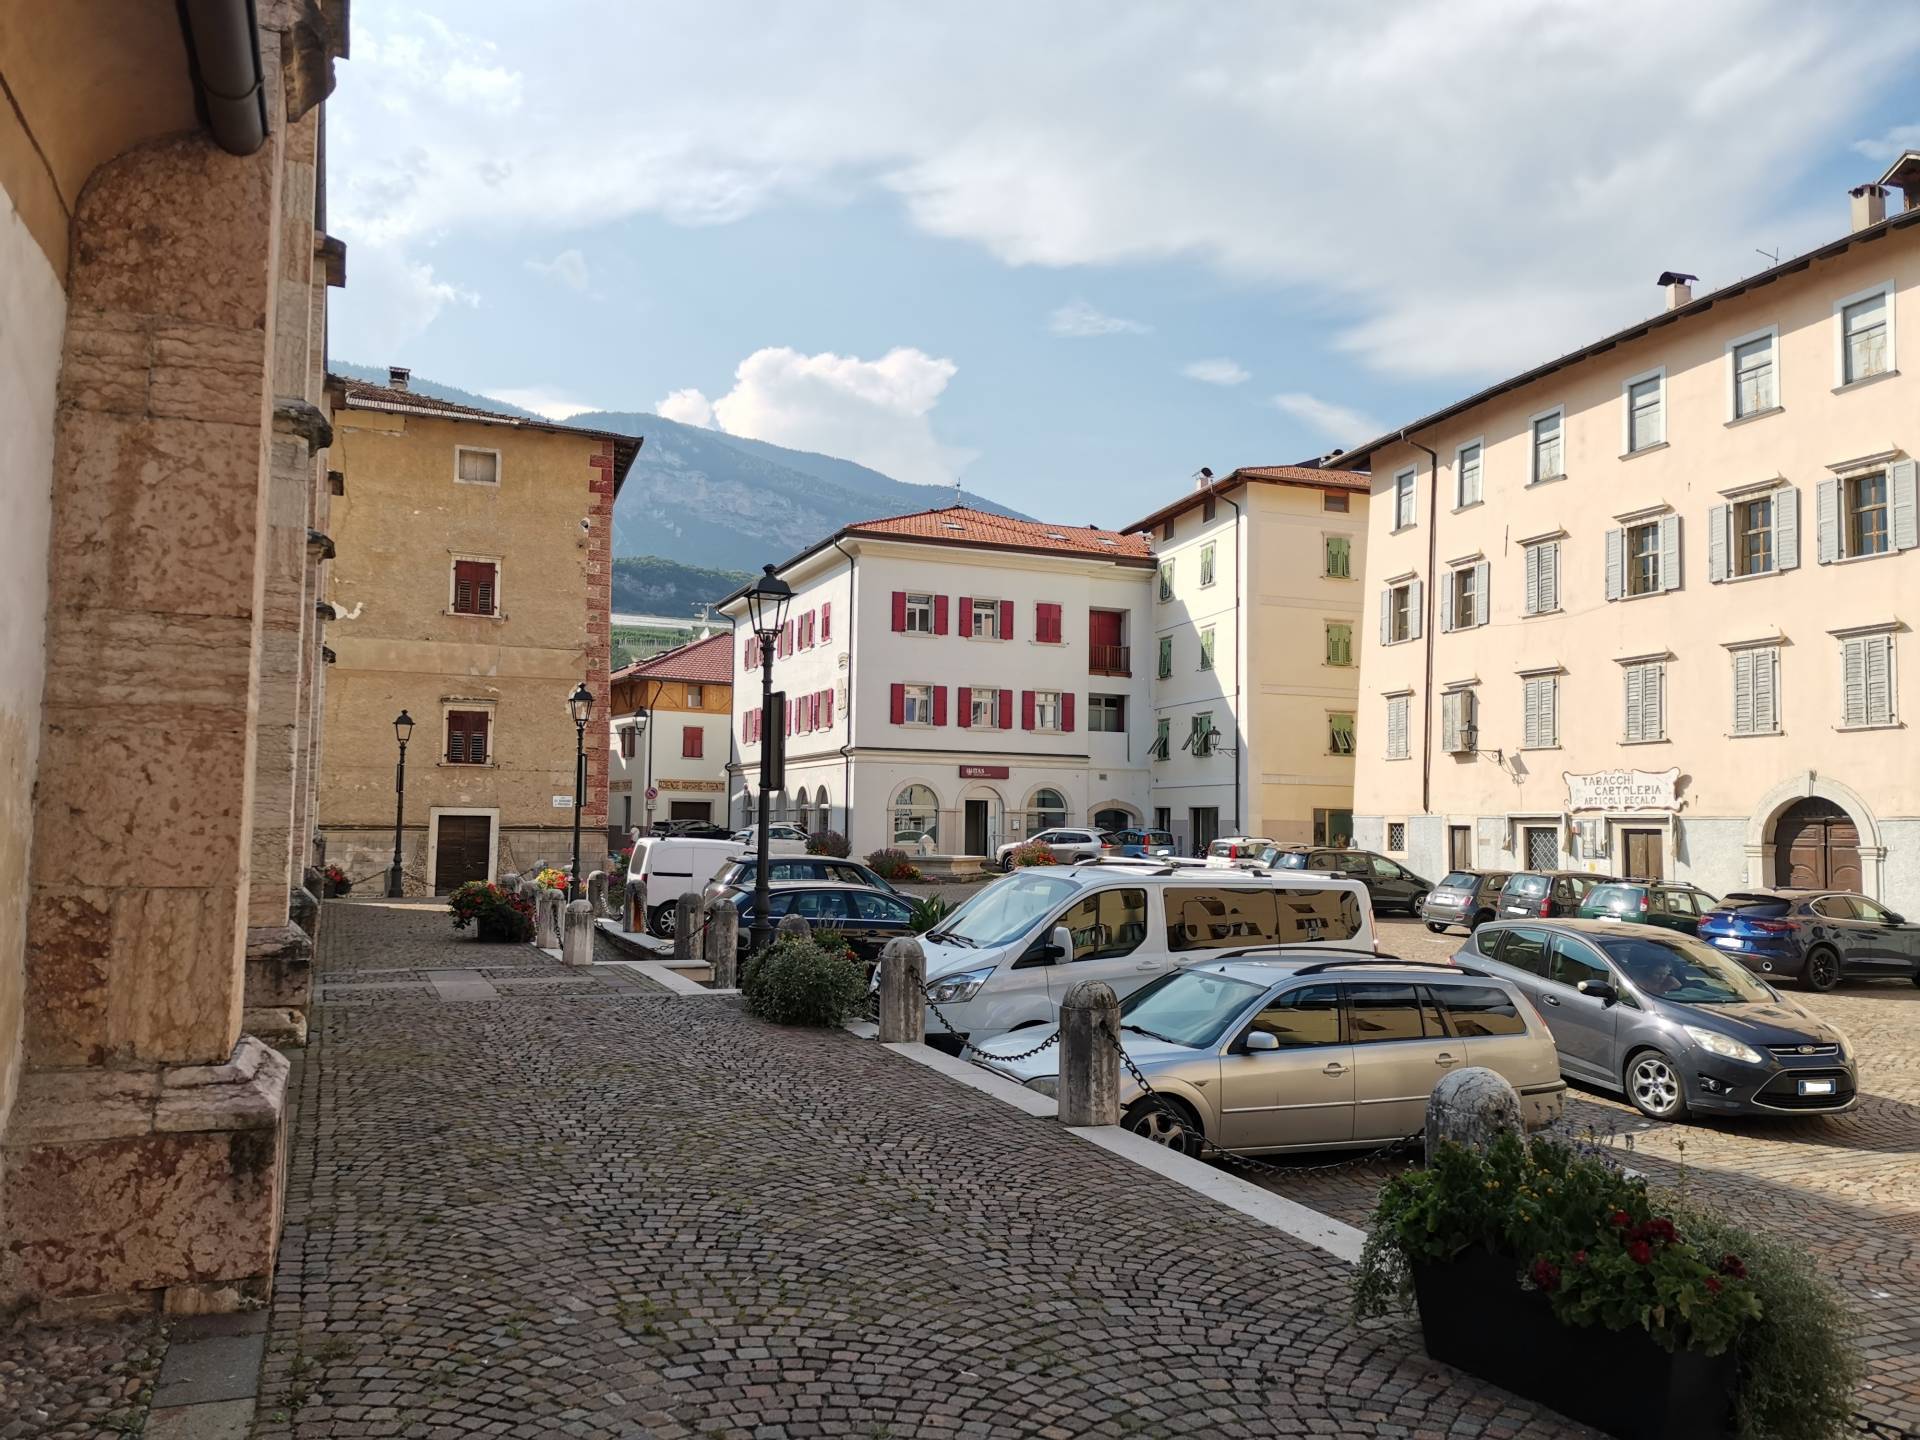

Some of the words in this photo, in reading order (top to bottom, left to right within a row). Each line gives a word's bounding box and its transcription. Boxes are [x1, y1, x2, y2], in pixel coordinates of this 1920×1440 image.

[1582, 776, 1633, 785] TABACCHI
[1594, 786, 1661, 795] CARTOLERIA
[1584, 797, 1621, 805] ARTICOLI
[1625, 796, 1656, 804] REGALO
